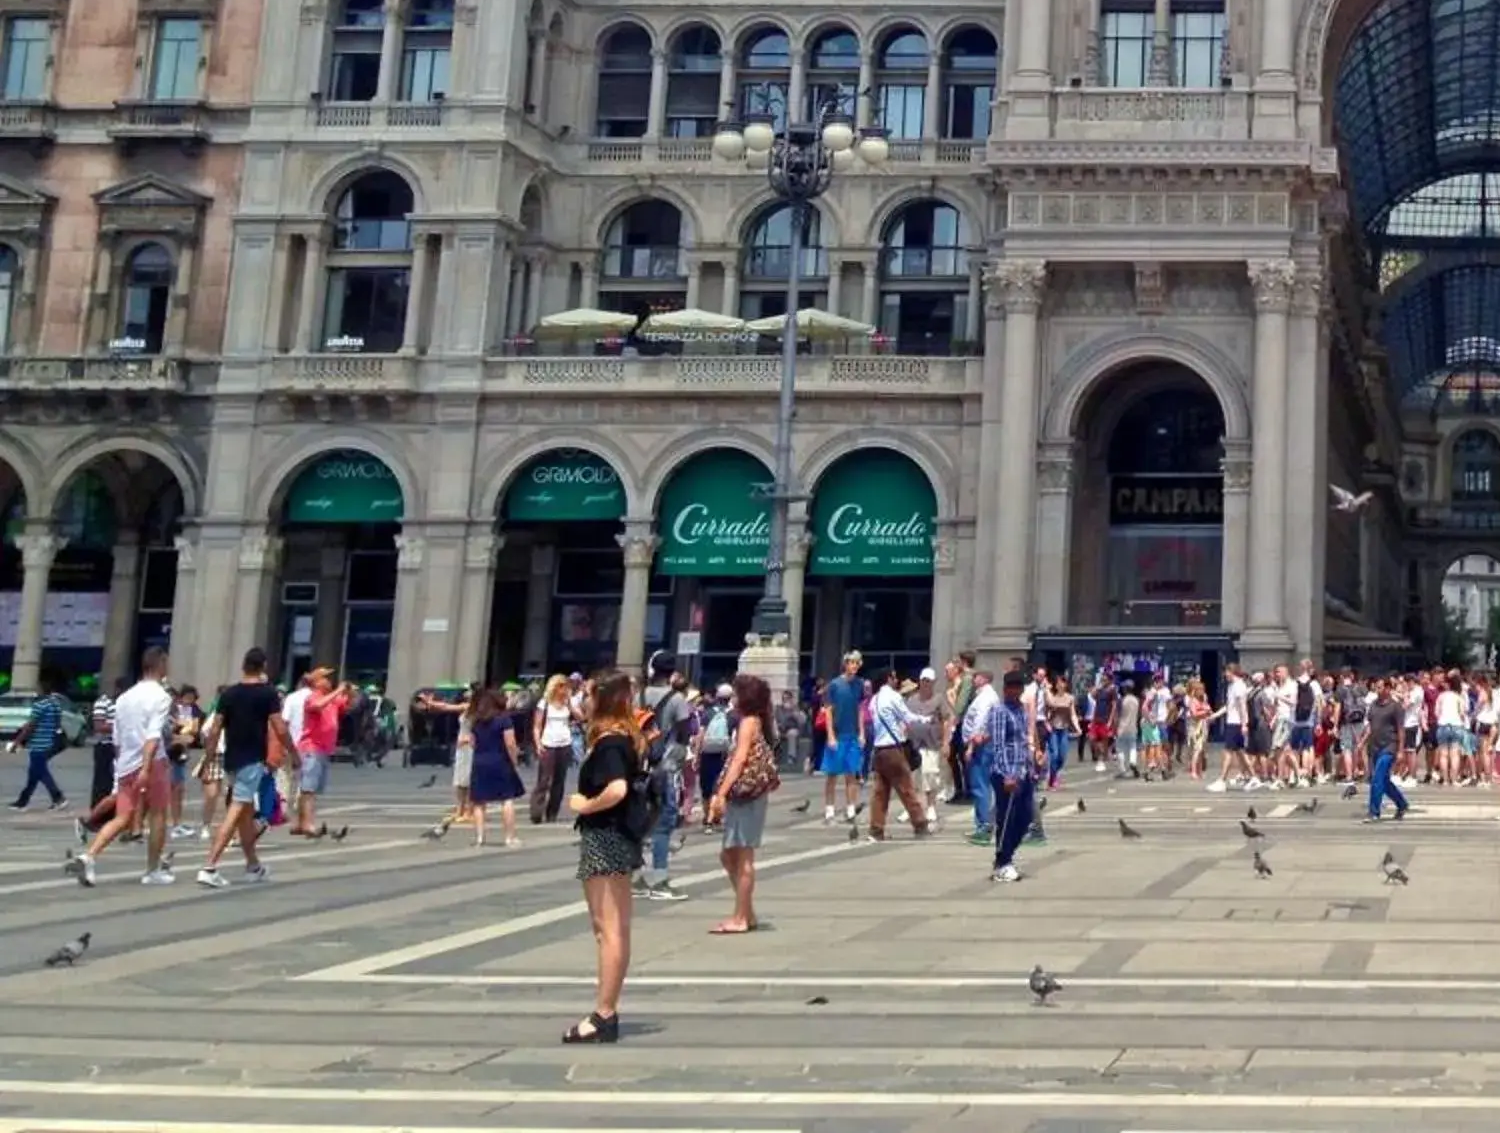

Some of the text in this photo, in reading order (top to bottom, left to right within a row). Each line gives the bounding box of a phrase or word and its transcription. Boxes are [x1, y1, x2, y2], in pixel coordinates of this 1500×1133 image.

[673, 503, 770, 544] Currado
[827, 503, 927, 544] Currado
[369, 695, 383, 716] 7
